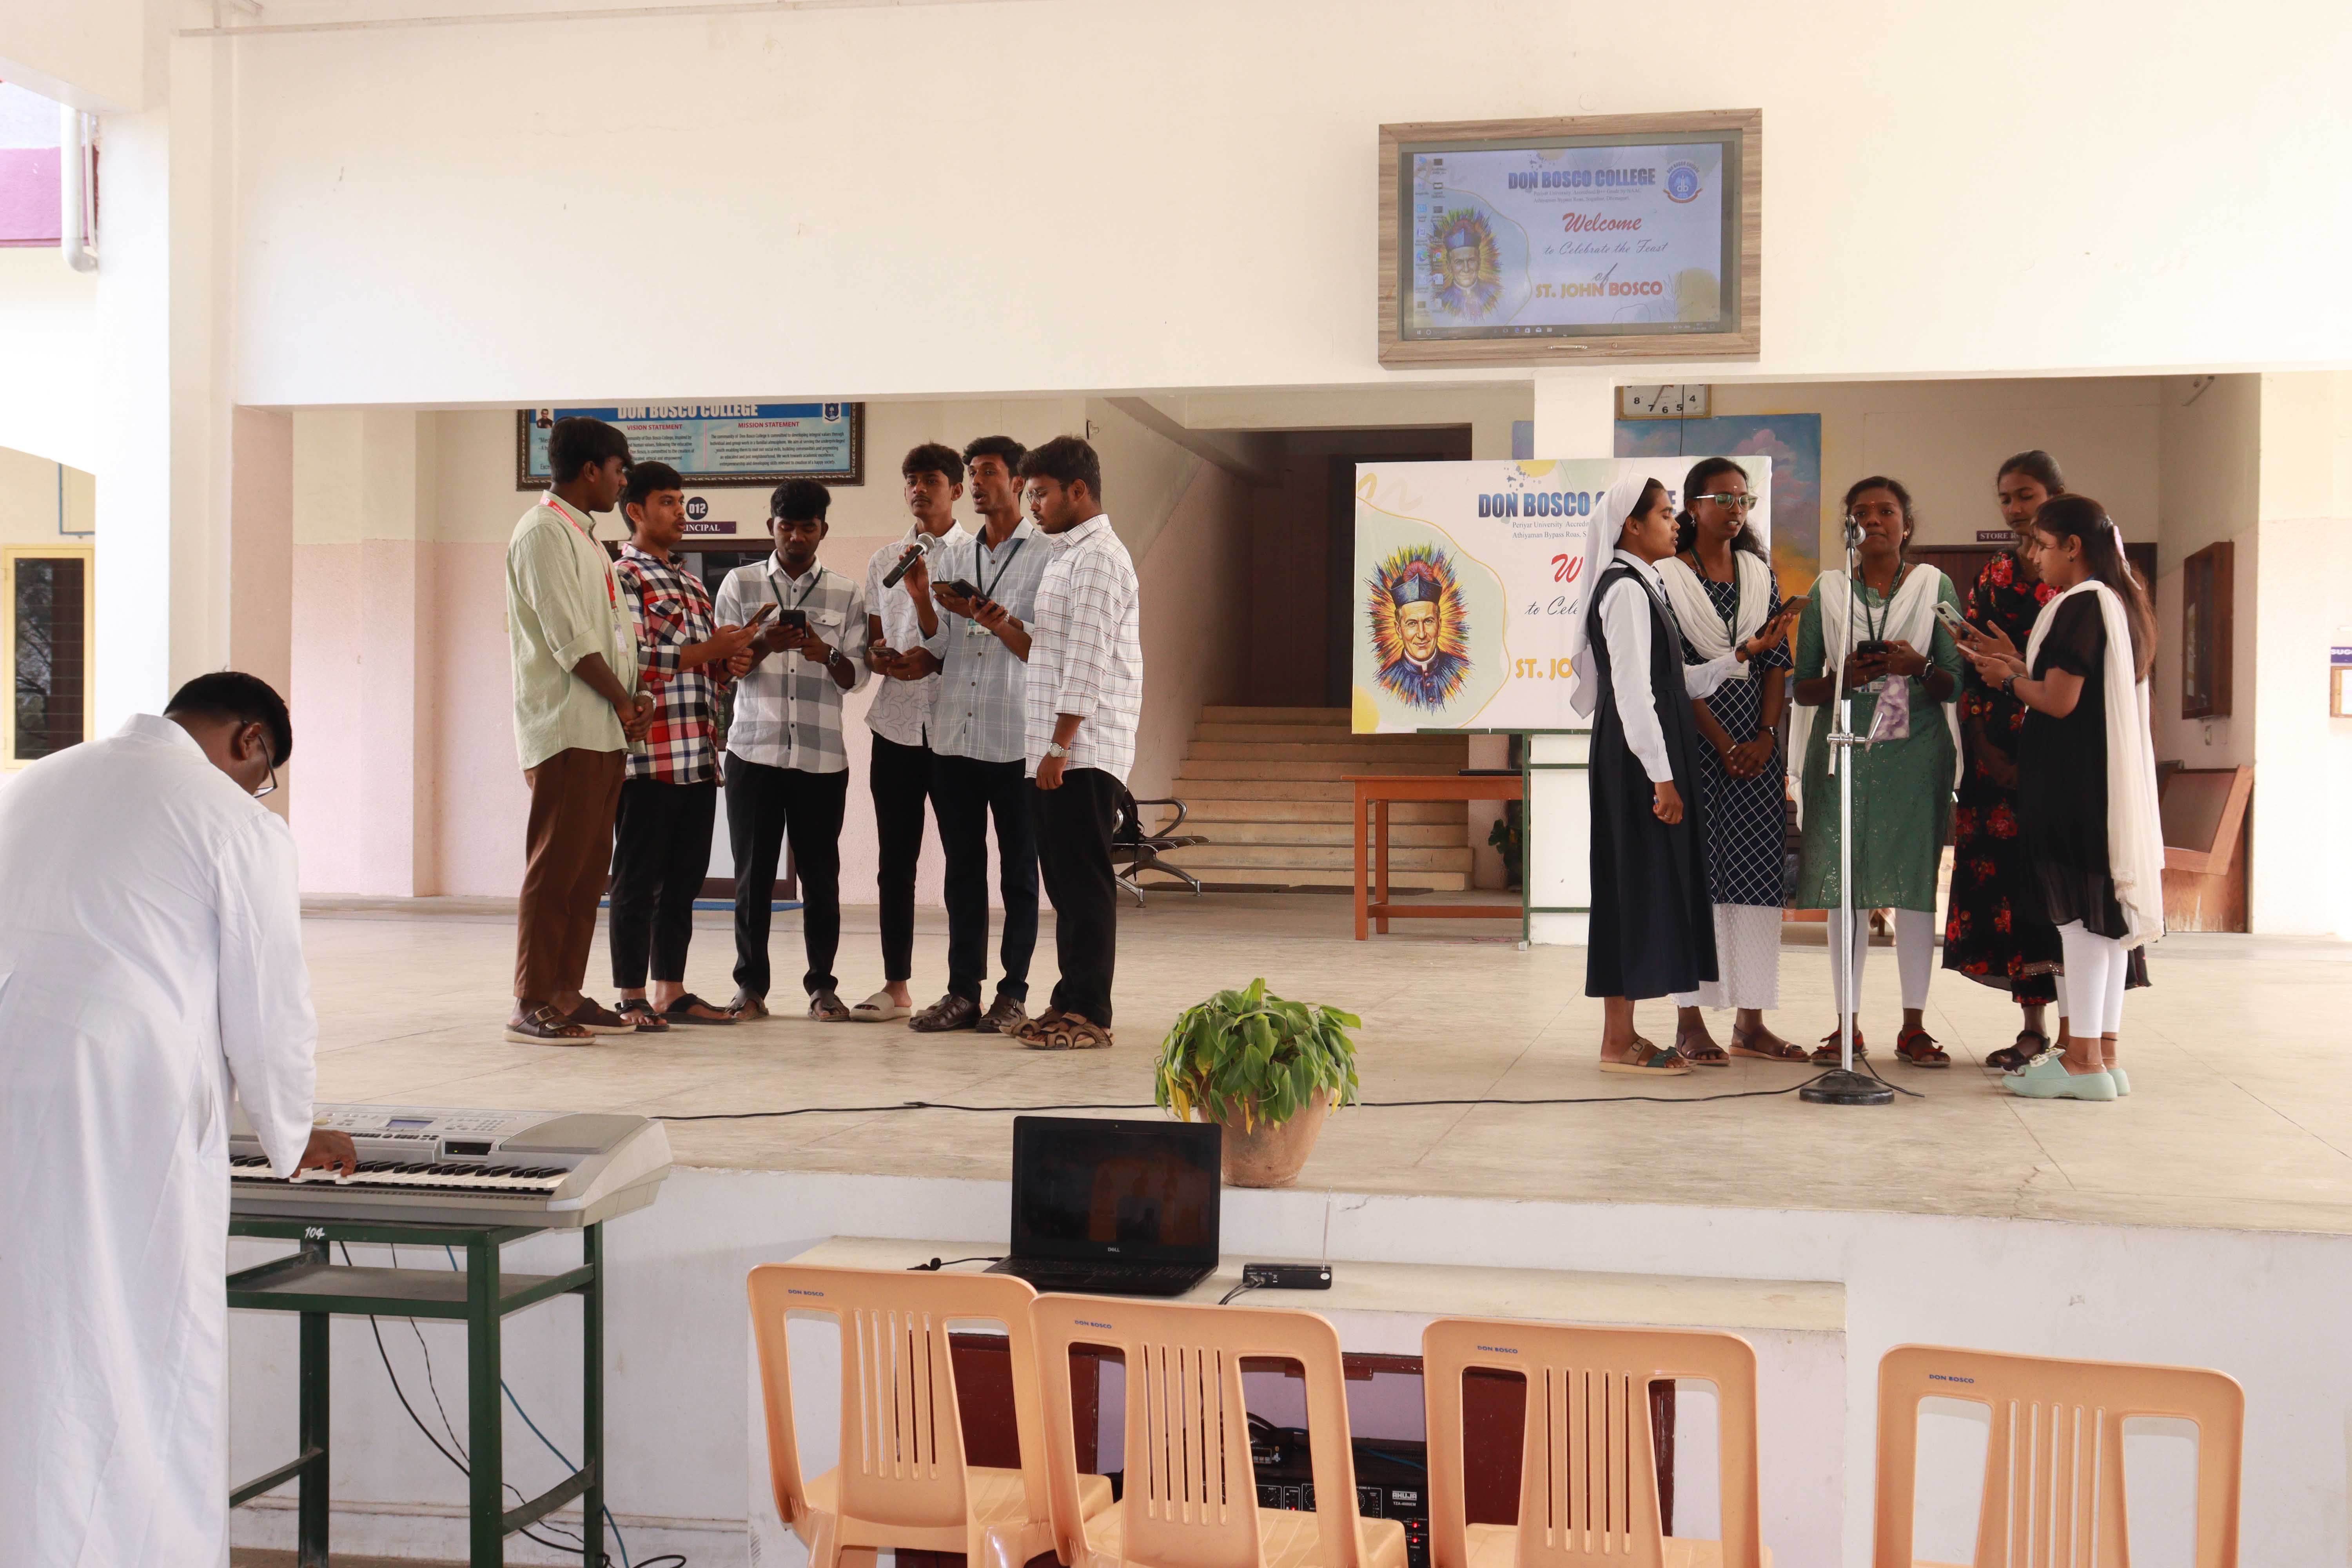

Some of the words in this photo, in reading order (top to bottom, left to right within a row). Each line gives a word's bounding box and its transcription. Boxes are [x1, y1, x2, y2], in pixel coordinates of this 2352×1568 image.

[1508, 172, 1538, 189] DON
[1542, 170, 1592, 188] BOSCO
[1595, 168, 1655, 186] COLLEGE
[1562, 212, 1642, 232] Welcome
[1544, 246, 1555, 255] to
[1559, 241, 1610, 255] Celebrate
[1613, 241, 1630, 254] the
[1636, 239, 1669, 254] Feast
[1592, 263, 1618, 289] of
[1535, 283, 1556, 298] ST.
[1561, 283, 1604, 299] JOHN
[1608, 281, 1663, 296] BOSCO
[617, 408, 646, 419] DON
[699, 404, 759, 417] COLLEGE
[689, 503, 706, 514] 012
[1478, 492, 1518, 518] DON
[1523, 491, 1591, 517] BOSCO
[1534, 521, 1563, 530] University
[1512, 532, 1543, 540] Athiyaman
[1544, 532, 1564, 540] Bypass
[1524, 601, 1540, 615] to
[1515, 658, 1543, 679] ST.
[305, 1226, 325, 1240] 104
[1392, 1492, 1417, 1500] AHUJA
